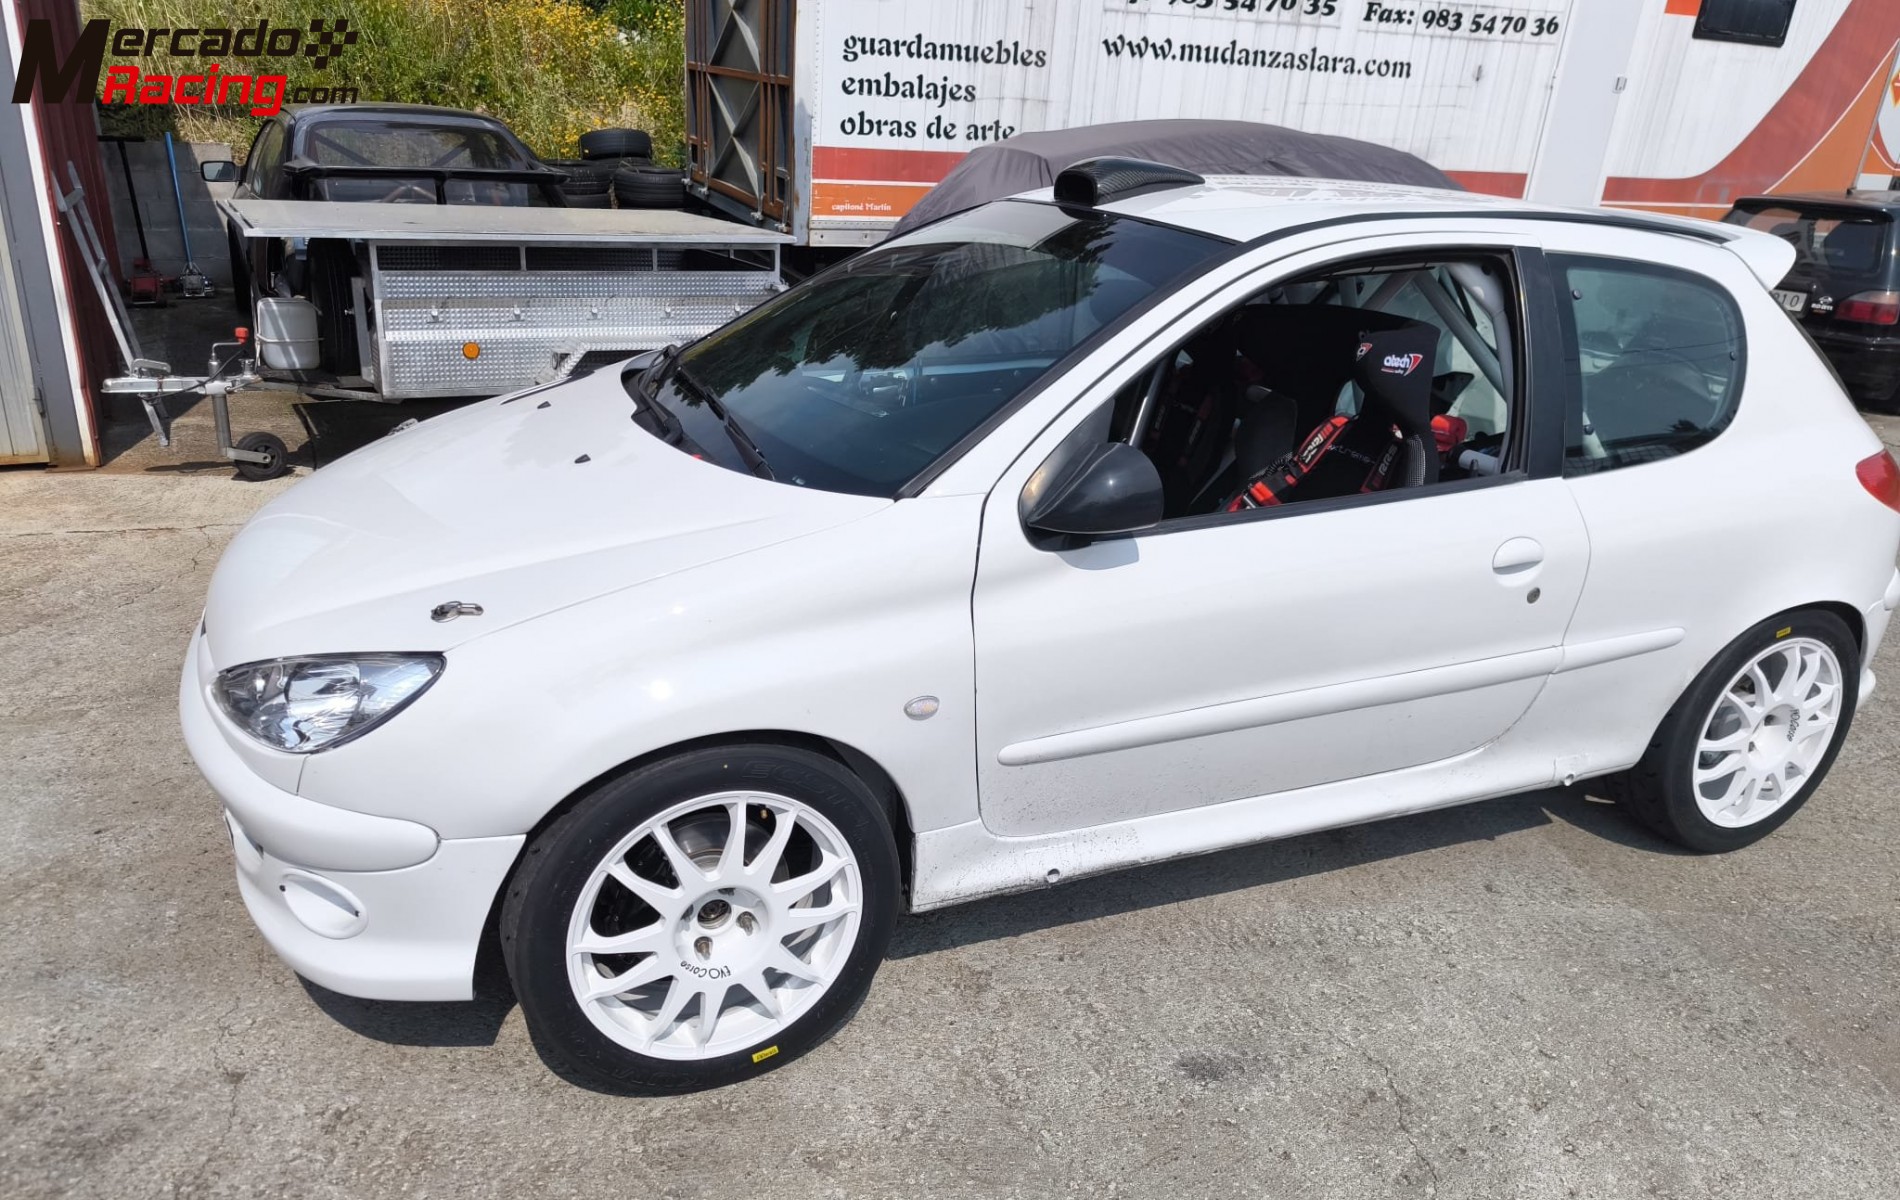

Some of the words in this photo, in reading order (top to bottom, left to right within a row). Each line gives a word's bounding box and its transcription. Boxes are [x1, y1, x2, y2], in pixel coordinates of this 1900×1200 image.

[1363, 1, 1415, 25] Fax:
[1422, 9, 1464, 32] 983
[1531, 16, 1560, 37] 36
[842, 33, 1047, 68] guardamuebles
[1101, 33, 1412, 79] www.mudanzaslara.com
[841, 71, 977, 109] embalajes
[839, 110, 917, 139] obras
[926, 114, 957, 141] de
[965, 119, 1015, 143] arte
